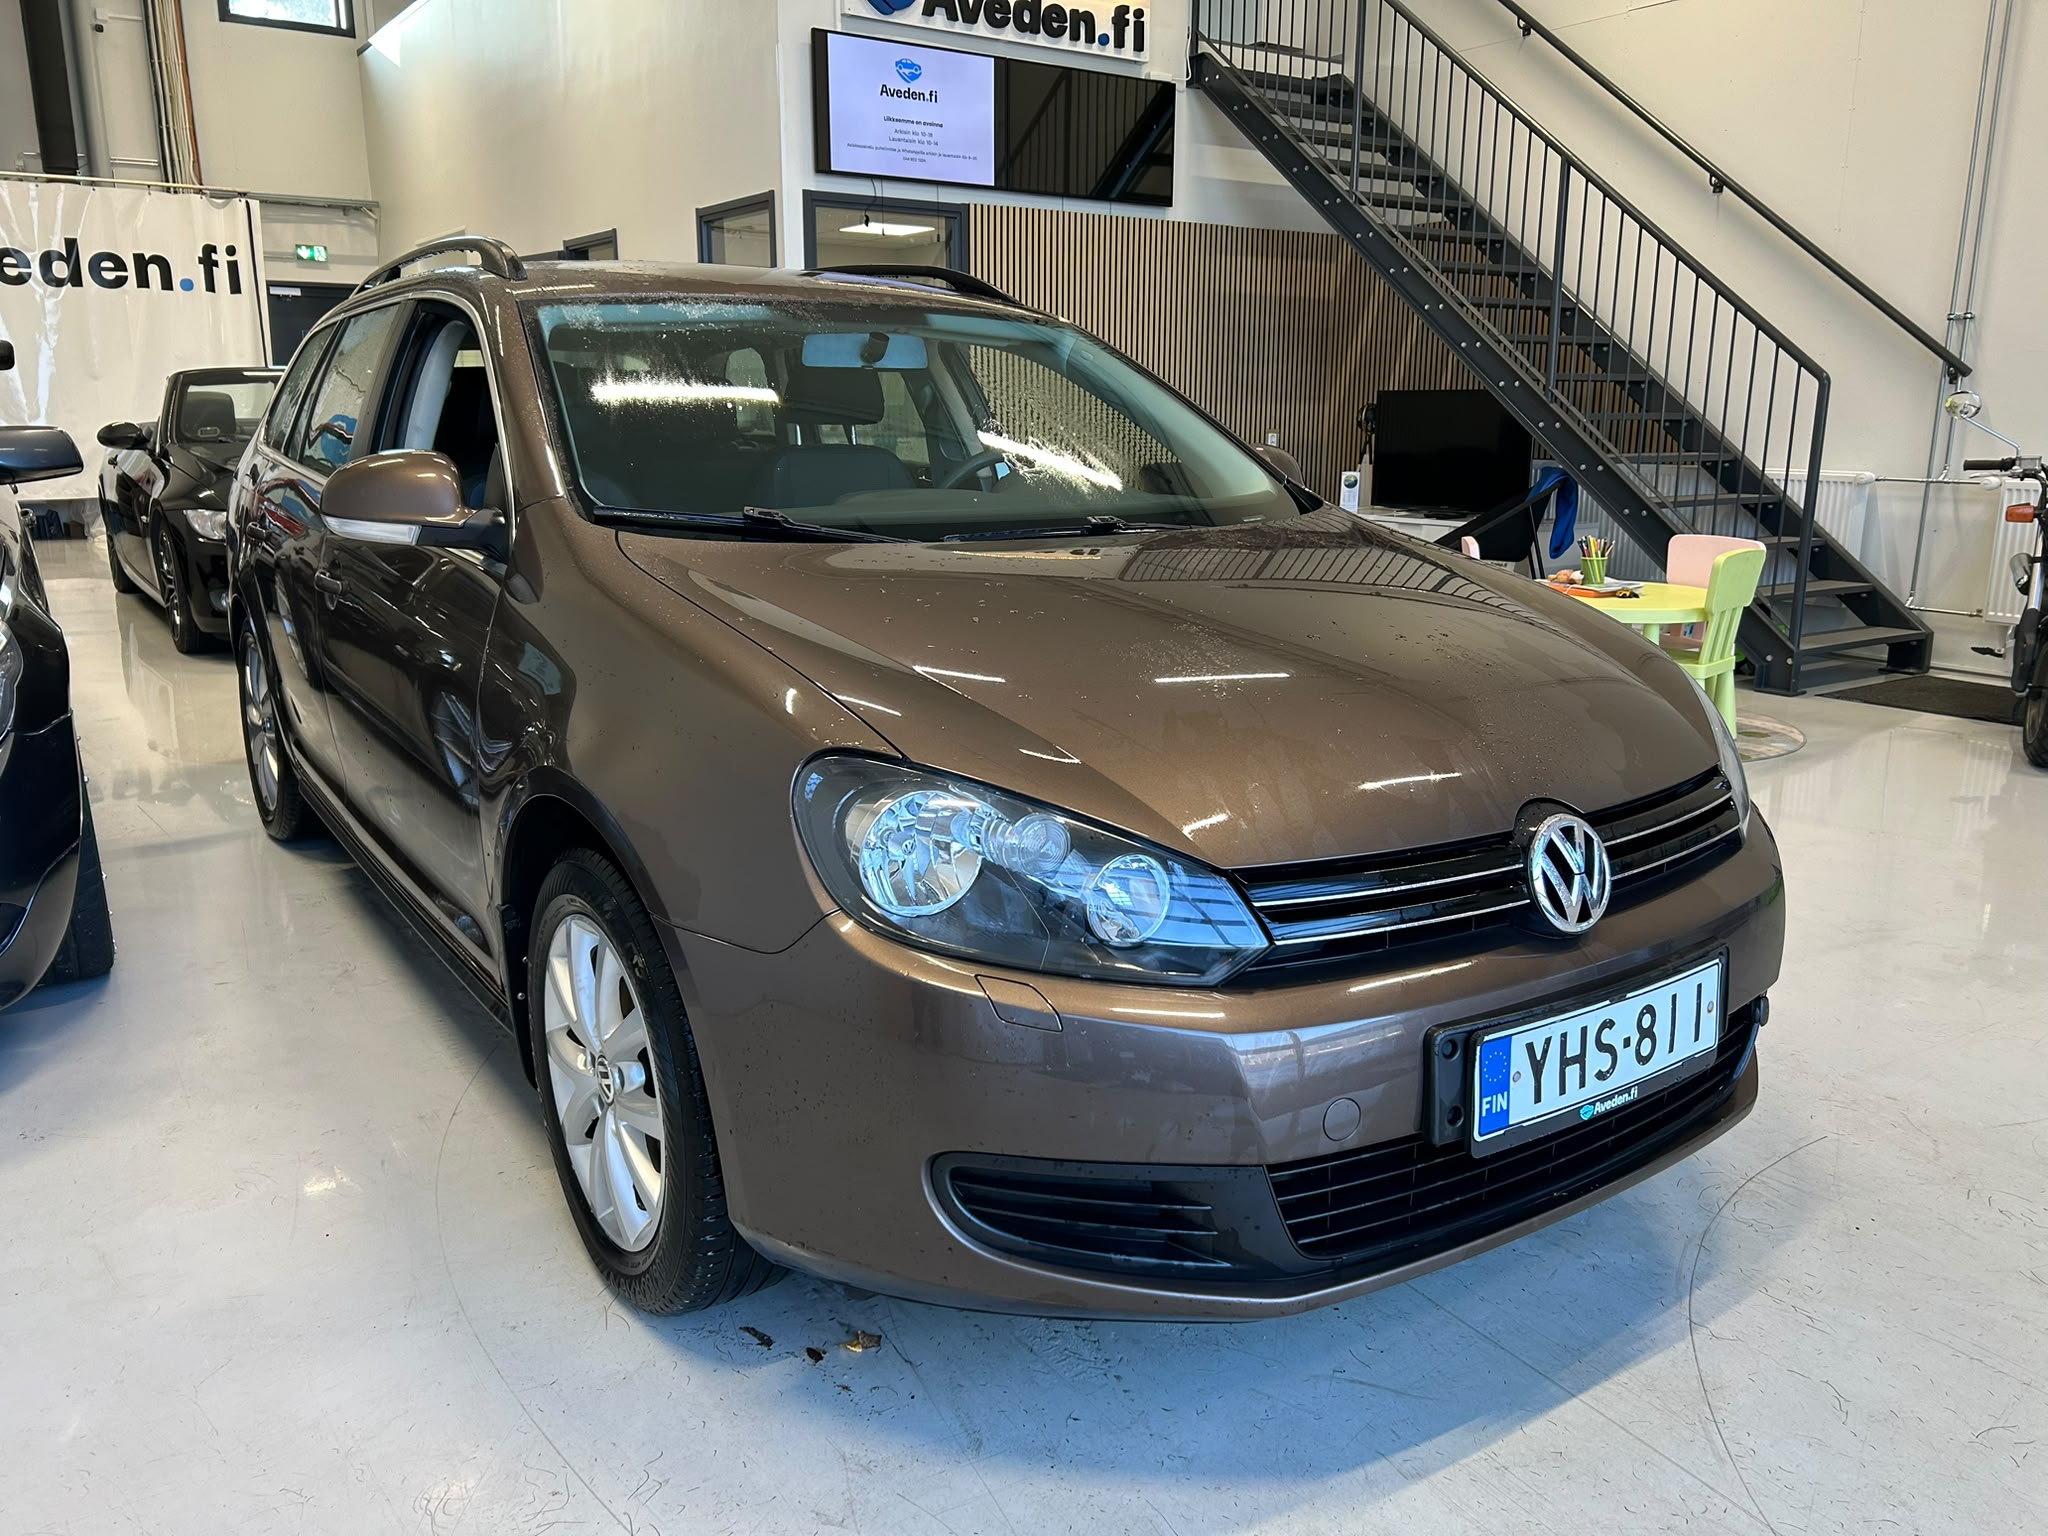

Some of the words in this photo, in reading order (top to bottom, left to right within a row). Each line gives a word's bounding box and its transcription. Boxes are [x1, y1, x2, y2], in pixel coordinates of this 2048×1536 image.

[880, 84, 937, 103] Aveden.fi
[1525, 982, 1702, 1105] YHS-811
[1481, 1090, 1508, 1117] FIN
[1593, 1086, 1638, 1116] Aveden.fi
